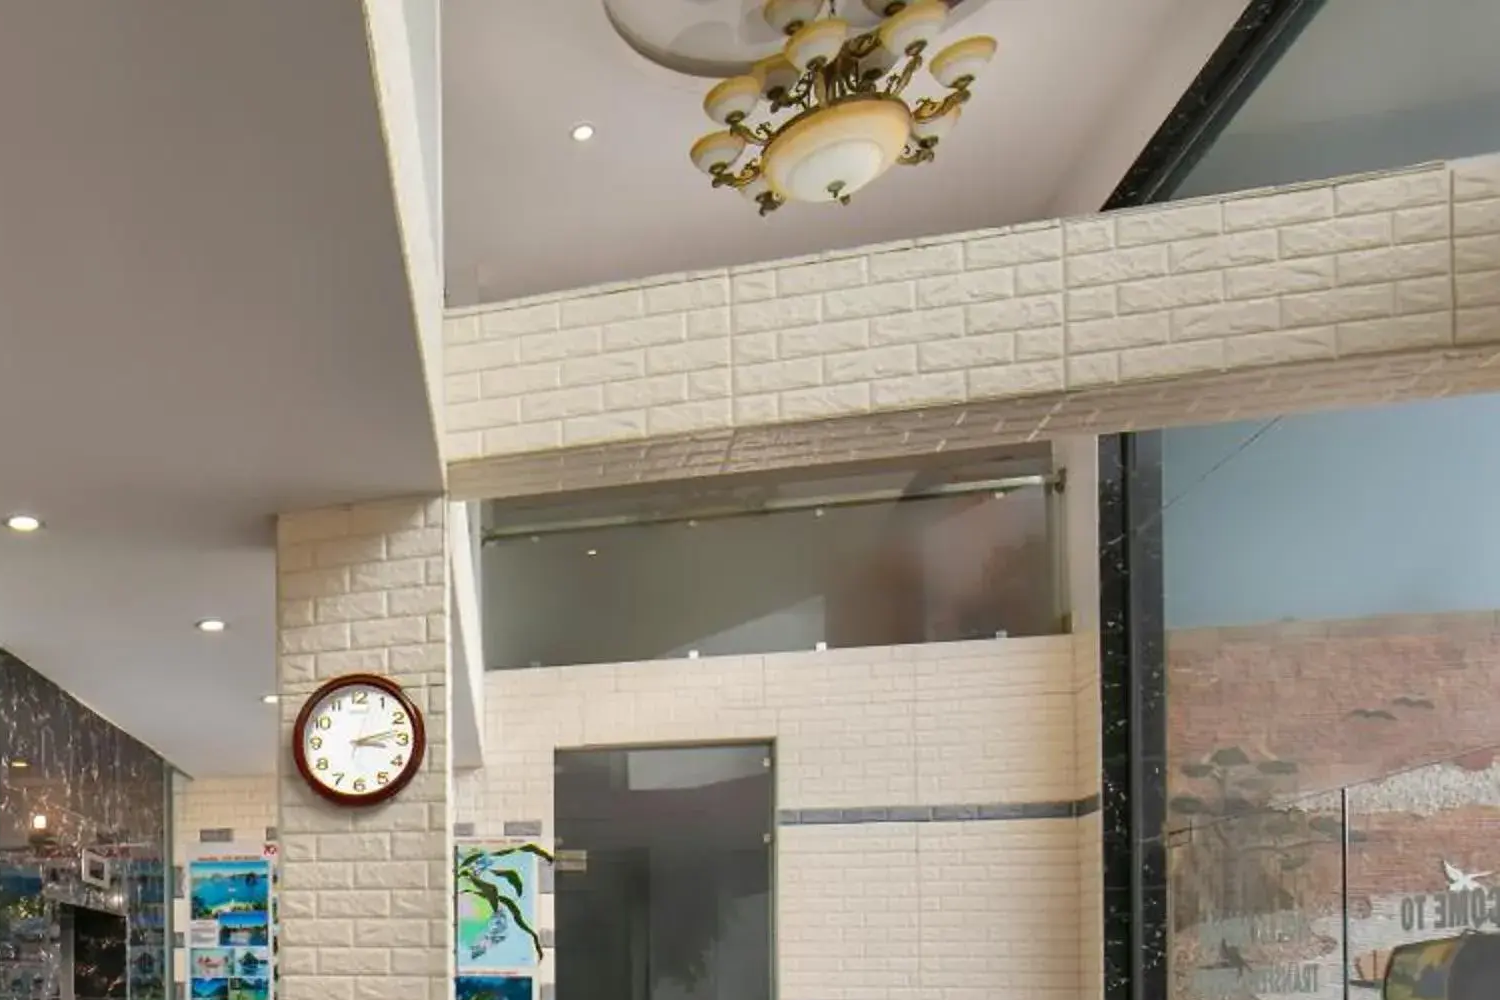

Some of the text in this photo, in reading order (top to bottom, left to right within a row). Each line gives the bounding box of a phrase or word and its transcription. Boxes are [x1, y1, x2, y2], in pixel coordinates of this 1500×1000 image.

[331, 697, 341, 711] 11
[351, 690, 368, 704] 12
[380, 696, 386, 709] 1
[315, 716, 331, 729] 10
[392, 711, 404, 725] 2
[310, 736, 323, 750] 9
[395, 732, 409, 746] 3
[316, 757, 329, 770] 8
[390, 754, 402, 766] 4
[332, 772, 344, 786] 7
[353, 777, 366, 792] 6
[377, 771, 389, 784] 5
